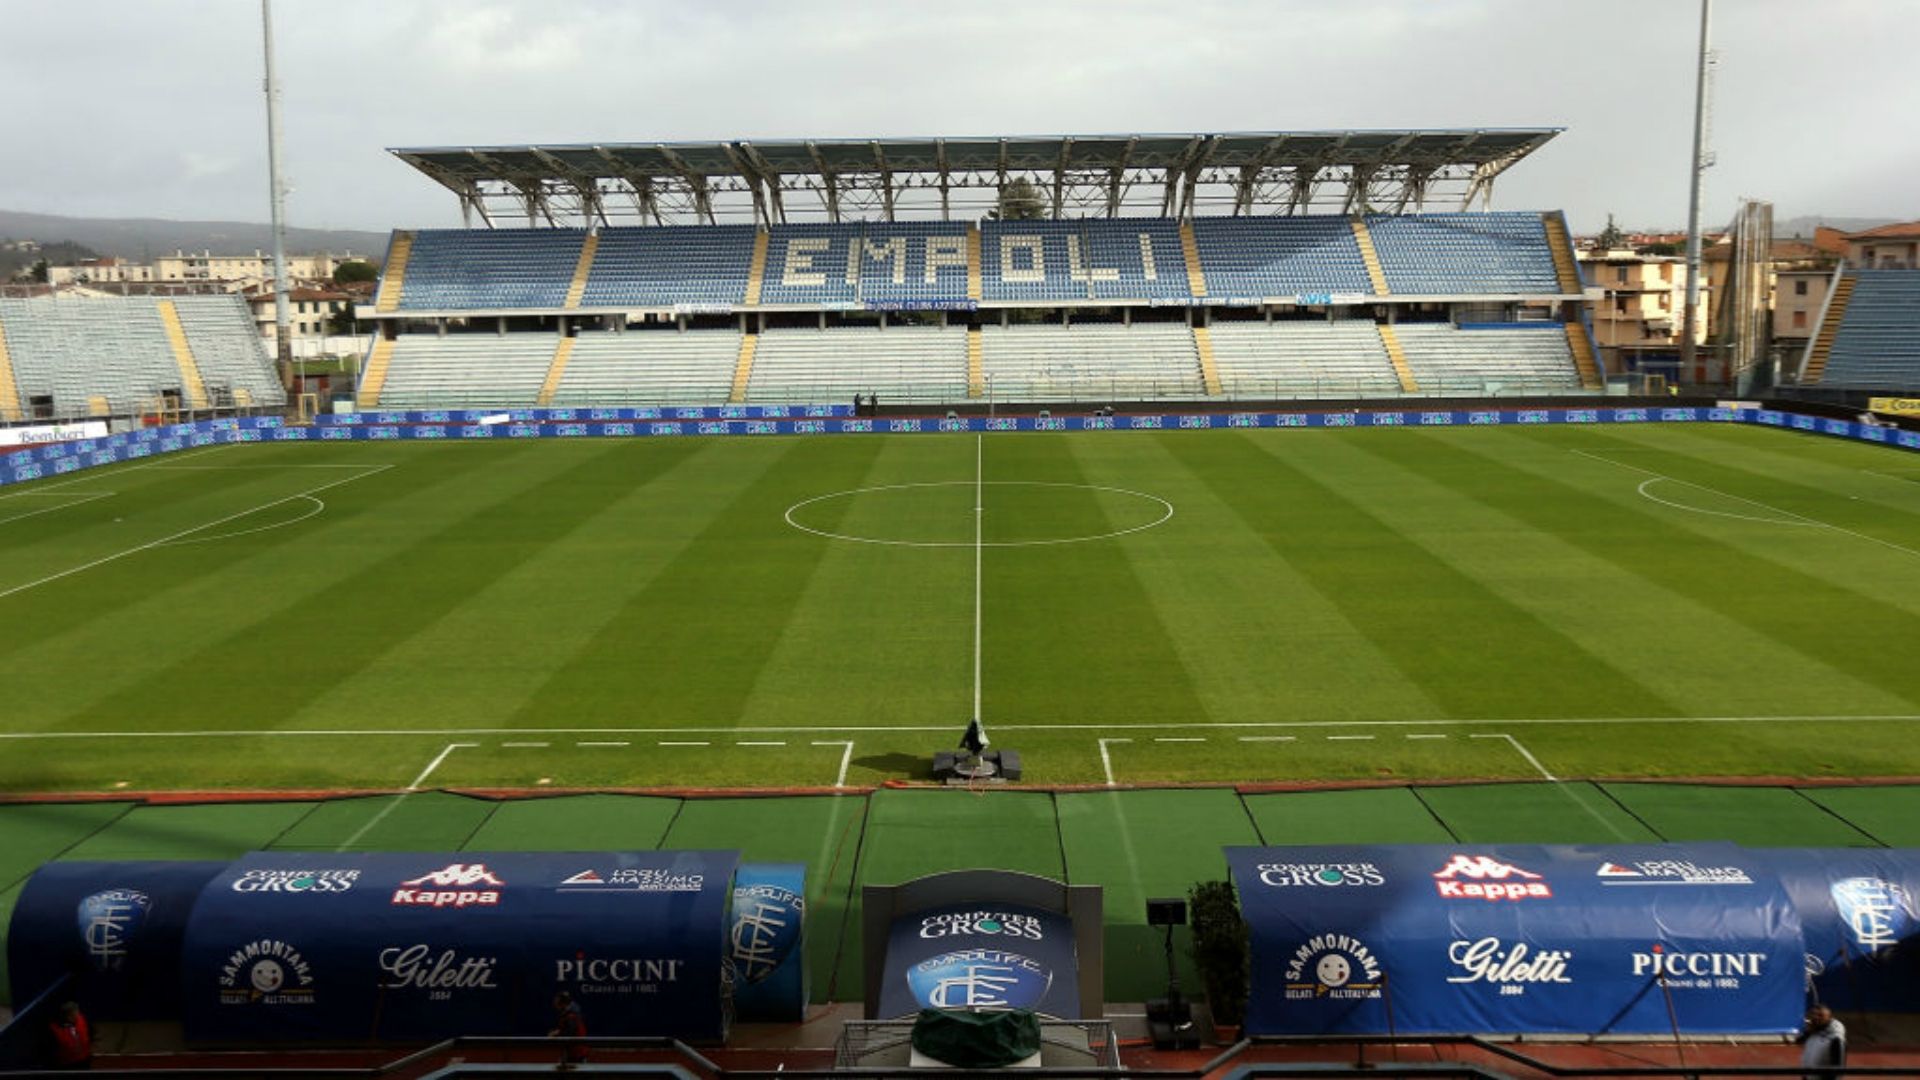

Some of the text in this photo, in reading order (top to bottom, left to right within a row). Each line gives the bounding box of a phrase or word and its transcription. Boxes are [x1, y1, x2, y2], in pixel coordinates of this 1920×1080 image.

[782, 233, 1157, 286] EMPOLI
[246, 869, 361, 881] COMPUTER
[1257, 863, 1378, 874] COMPUTER
[1259, 868, 1386, 886] GROSS
[232, 875, 355, 892] GROSS
[608, 874, 704, 885] MASSIMO
[391, 889, 498, 908] Kappa
[1436, 880, 1551, 901] Kappa
[919, 914, 1043, 941] GROSS
[922, 911, 1041, 928] COMPUTER
[218, 939, 315, 987] SAMMONTANA
[378, 944, 497, 988] Giletti
[1286, 933, 1382, 981] SAMMONTANA
[1447, 937, 1573, 984] Giletti
